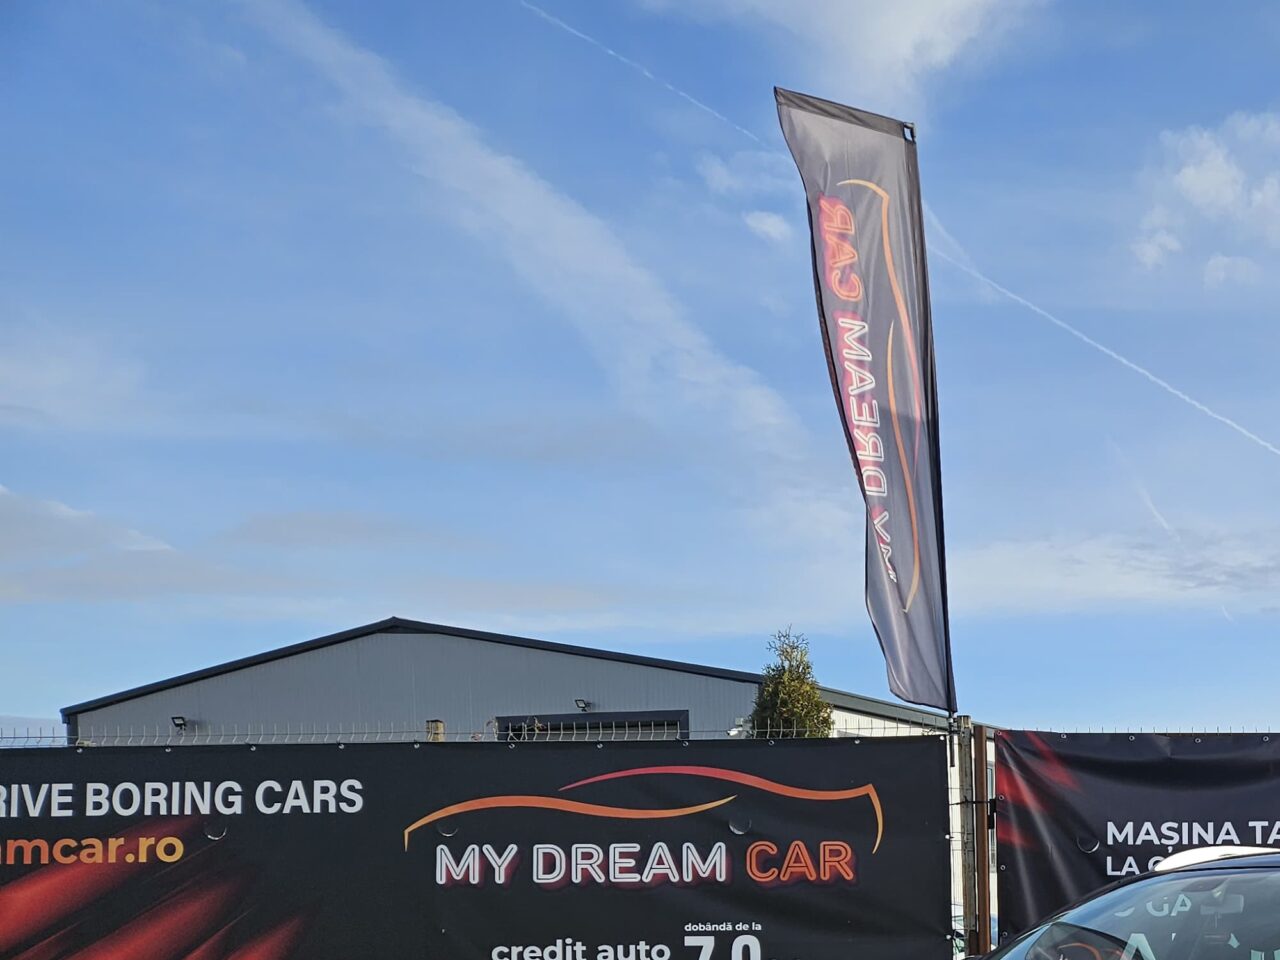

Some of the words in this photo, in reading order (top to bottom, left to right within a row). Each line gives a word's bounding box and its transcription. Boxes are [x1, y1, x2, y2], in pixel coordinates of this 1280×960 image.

[85, 781, 243, 818] BORING
[254, 779, 364, 814] CARS
[0, 836, 184, 865] mcar.ro
[1106, 821, 1241, 853] MAȘINA
[435, 843, 518, 885] MY
[532, 841, 727, 883] DREAM
[745, 840, 854, 882] CAR
[1106, 856, 1140, 876] LA
[684, 921, 733, 931] dobândă
[735, 922, 750, 931] de
[751, 921, 762, 931] la
